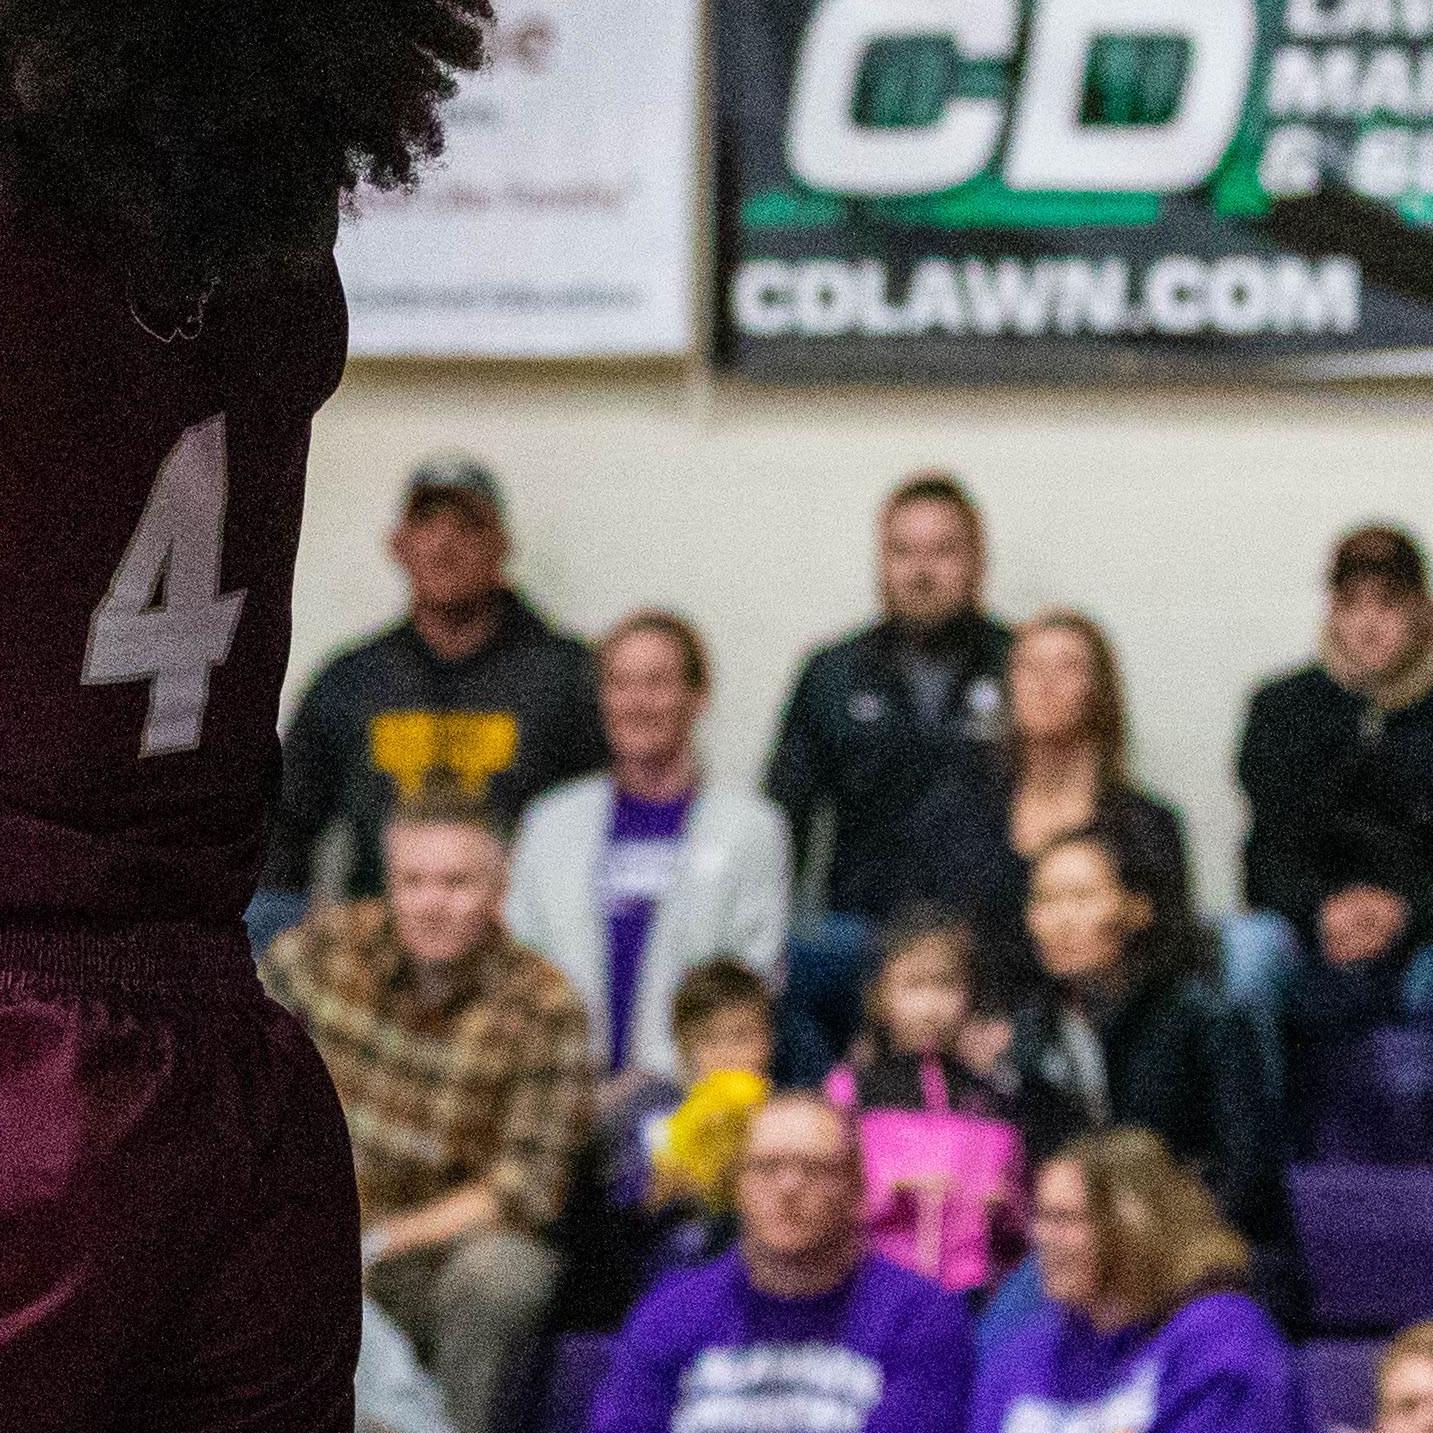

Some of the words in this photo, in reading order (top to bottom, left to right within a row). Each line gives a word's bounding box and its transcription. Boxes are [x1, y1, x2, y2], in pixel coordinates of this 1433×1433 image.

[1266, 44, 1433, 116] MA
[730, 253, 1362, 338] CDLAWN.COM
[80, 411, 248, 759] 4
